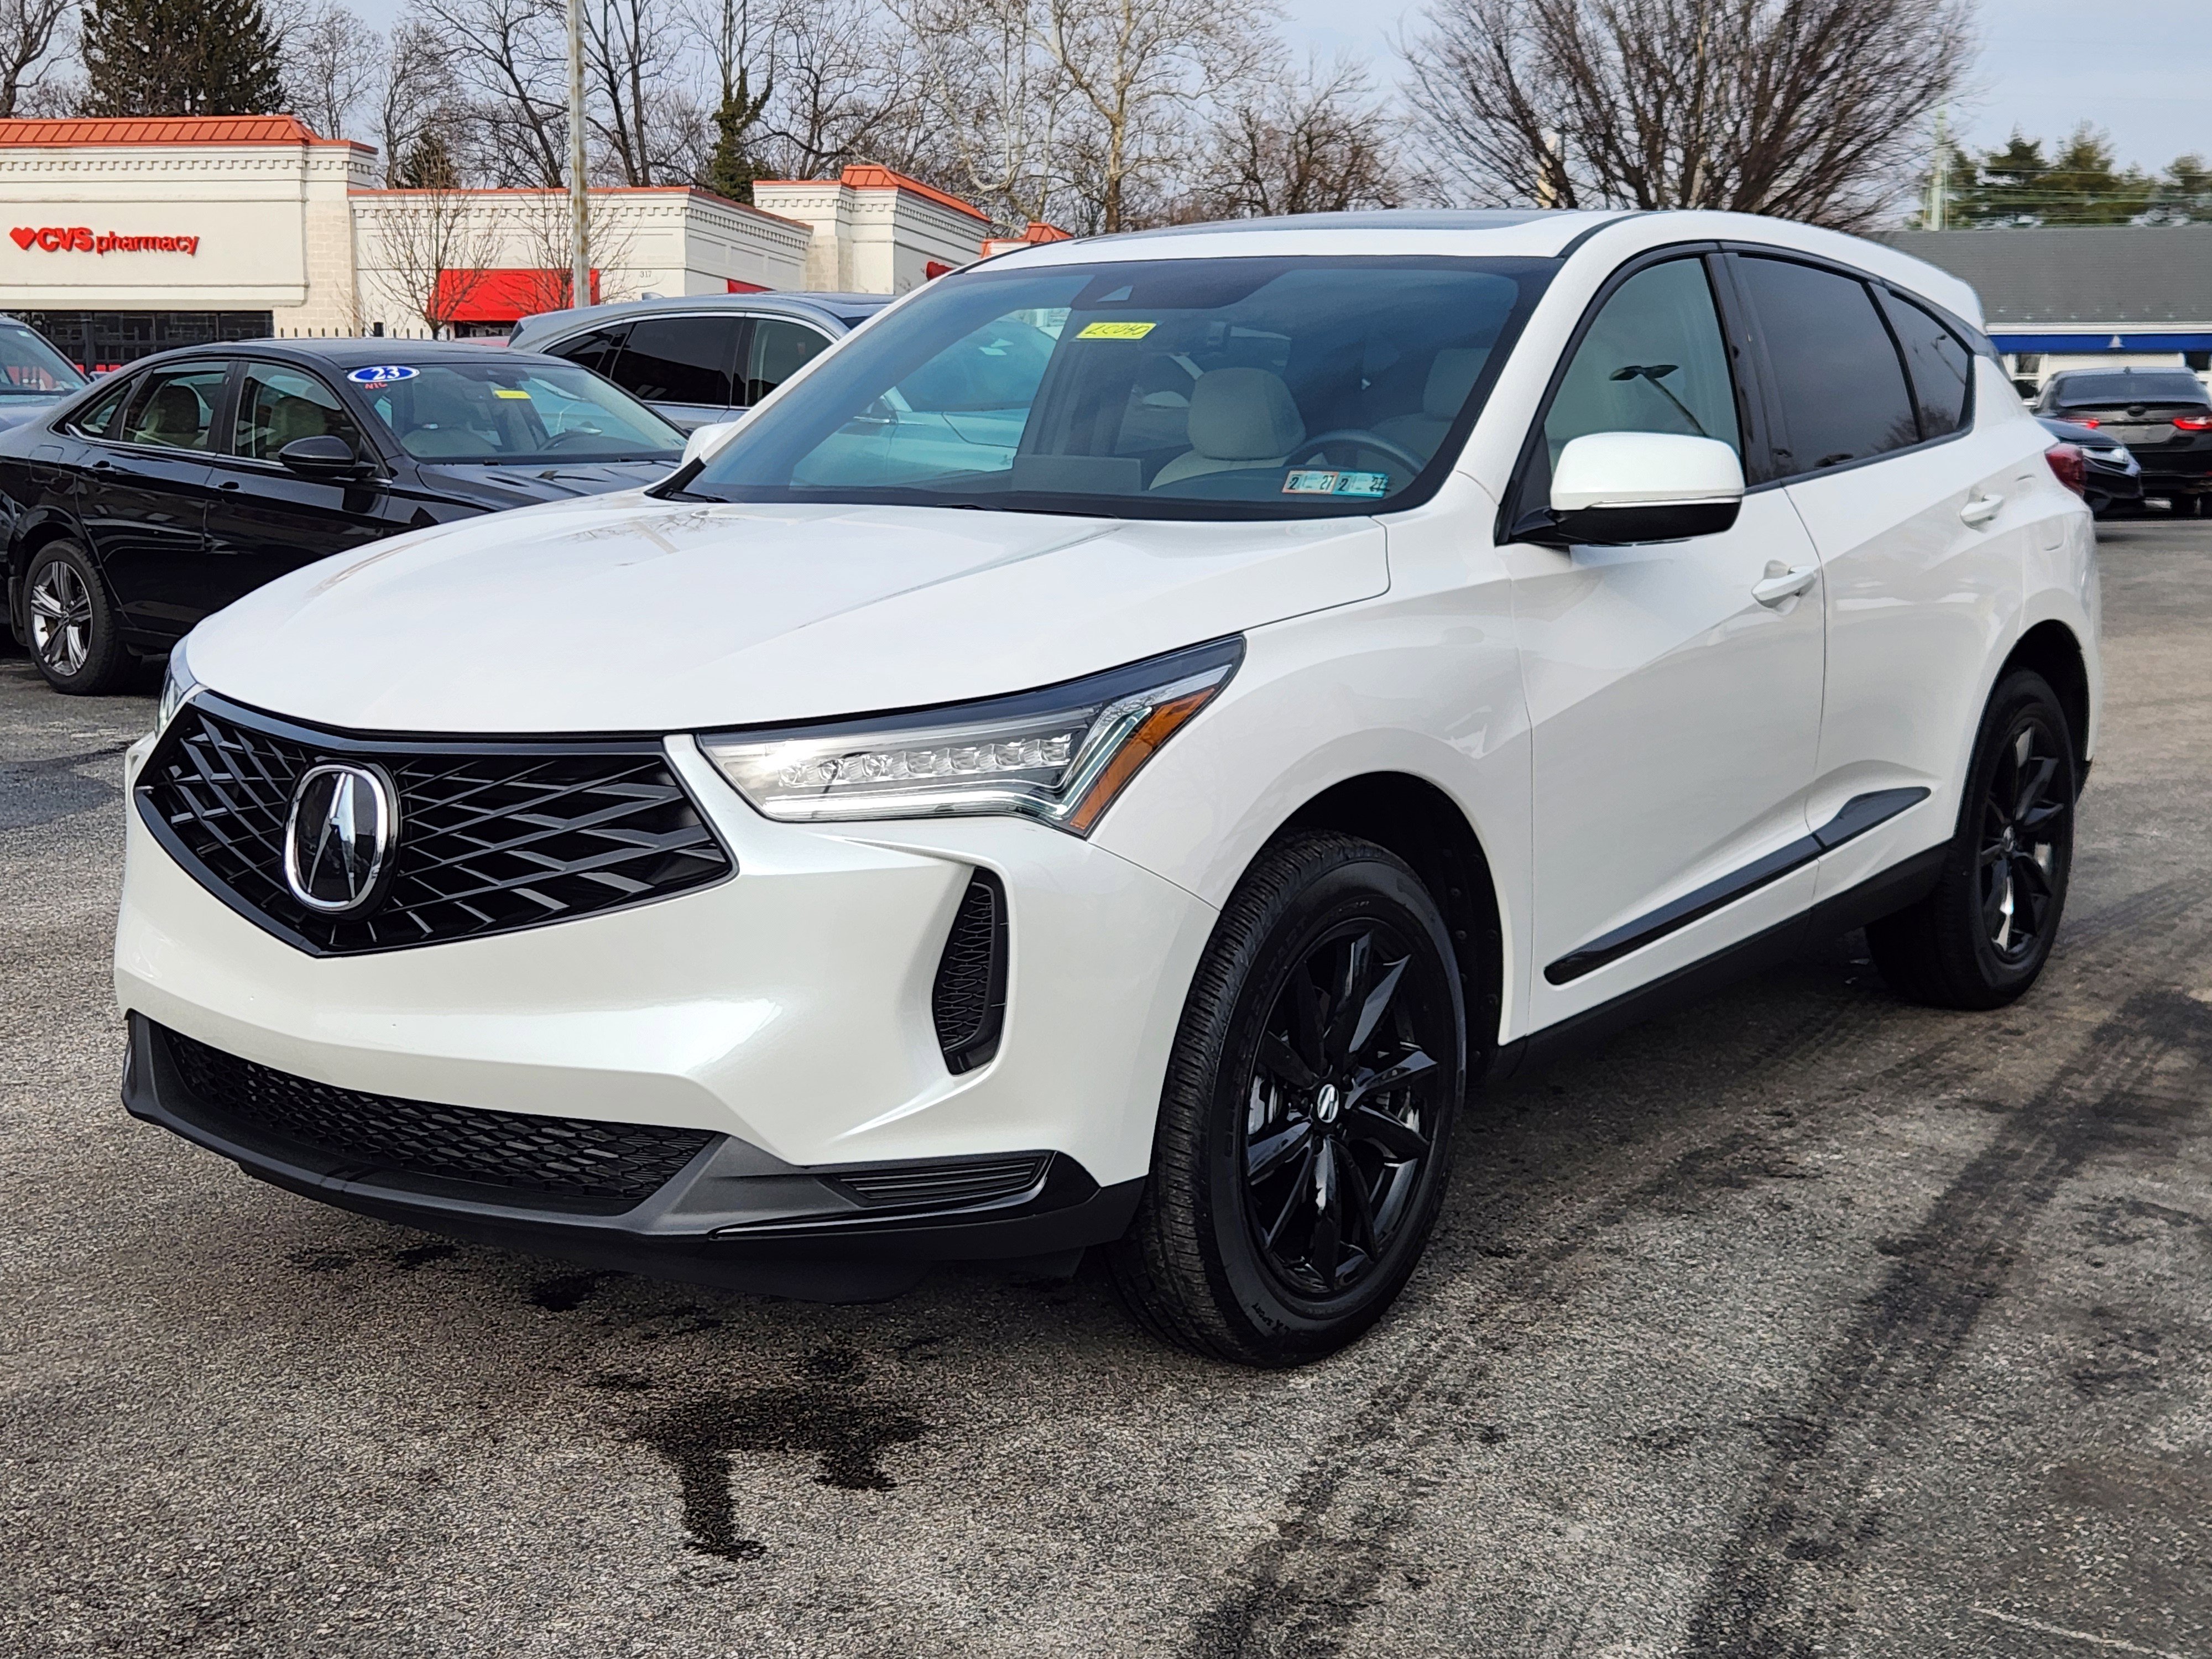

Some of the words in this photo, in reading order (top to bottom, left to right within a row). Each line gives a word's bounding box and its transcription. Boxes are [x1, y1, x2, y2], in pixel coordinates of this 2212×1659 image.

[36, 227, 95, 252] CVS
[97, 231, 200, 256] pharmacy
[372, 366, 400, 380] 23
[1288, 477, 1300, 490] 2
[1319, 475, 1334, 490] 27
[1338, 478, 1349, 491] 2
